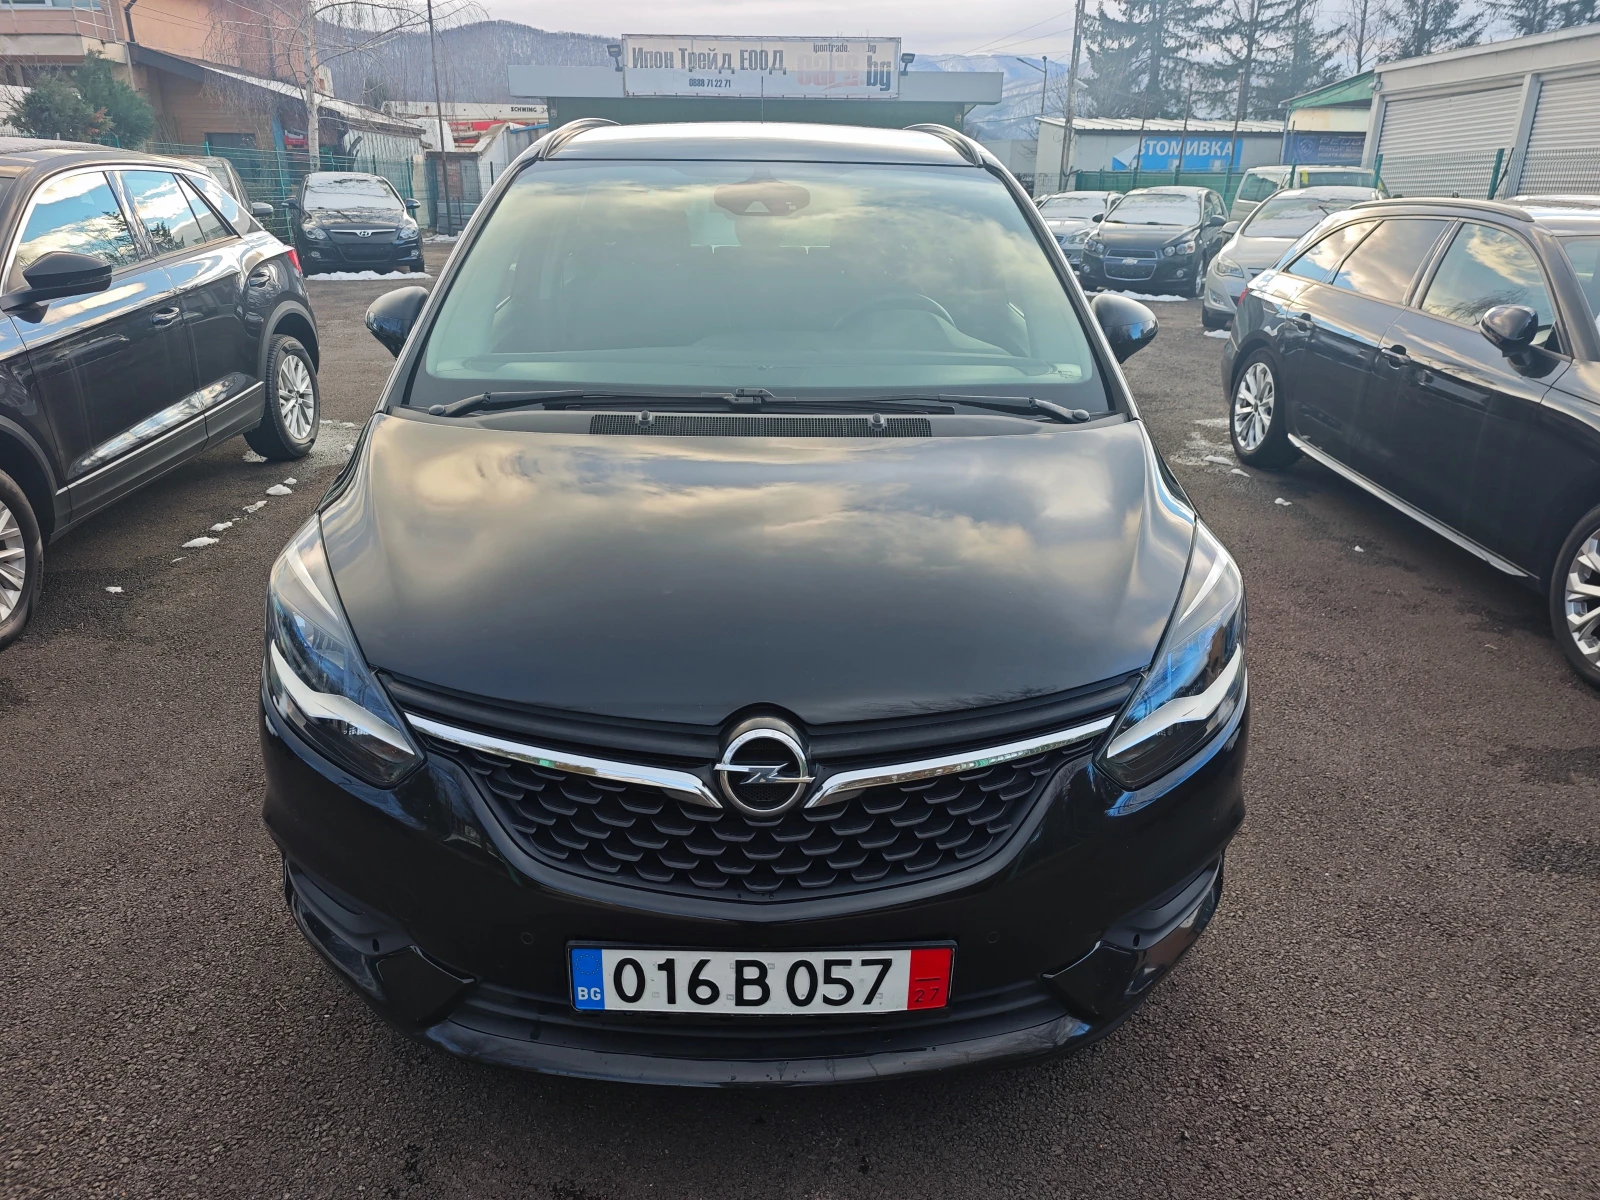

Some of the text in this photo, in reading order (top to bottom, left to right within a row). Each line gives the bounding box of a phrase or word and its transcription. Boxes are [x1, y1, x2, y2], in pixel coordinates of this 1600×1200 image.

[632, 47, 787, 75] Ипон Трейд ЕООД
[688, 78, 731, 88] 0888 71 22 71
[577, 986, 602, 1001] BG
[915, 987, 940, 1003] 27
